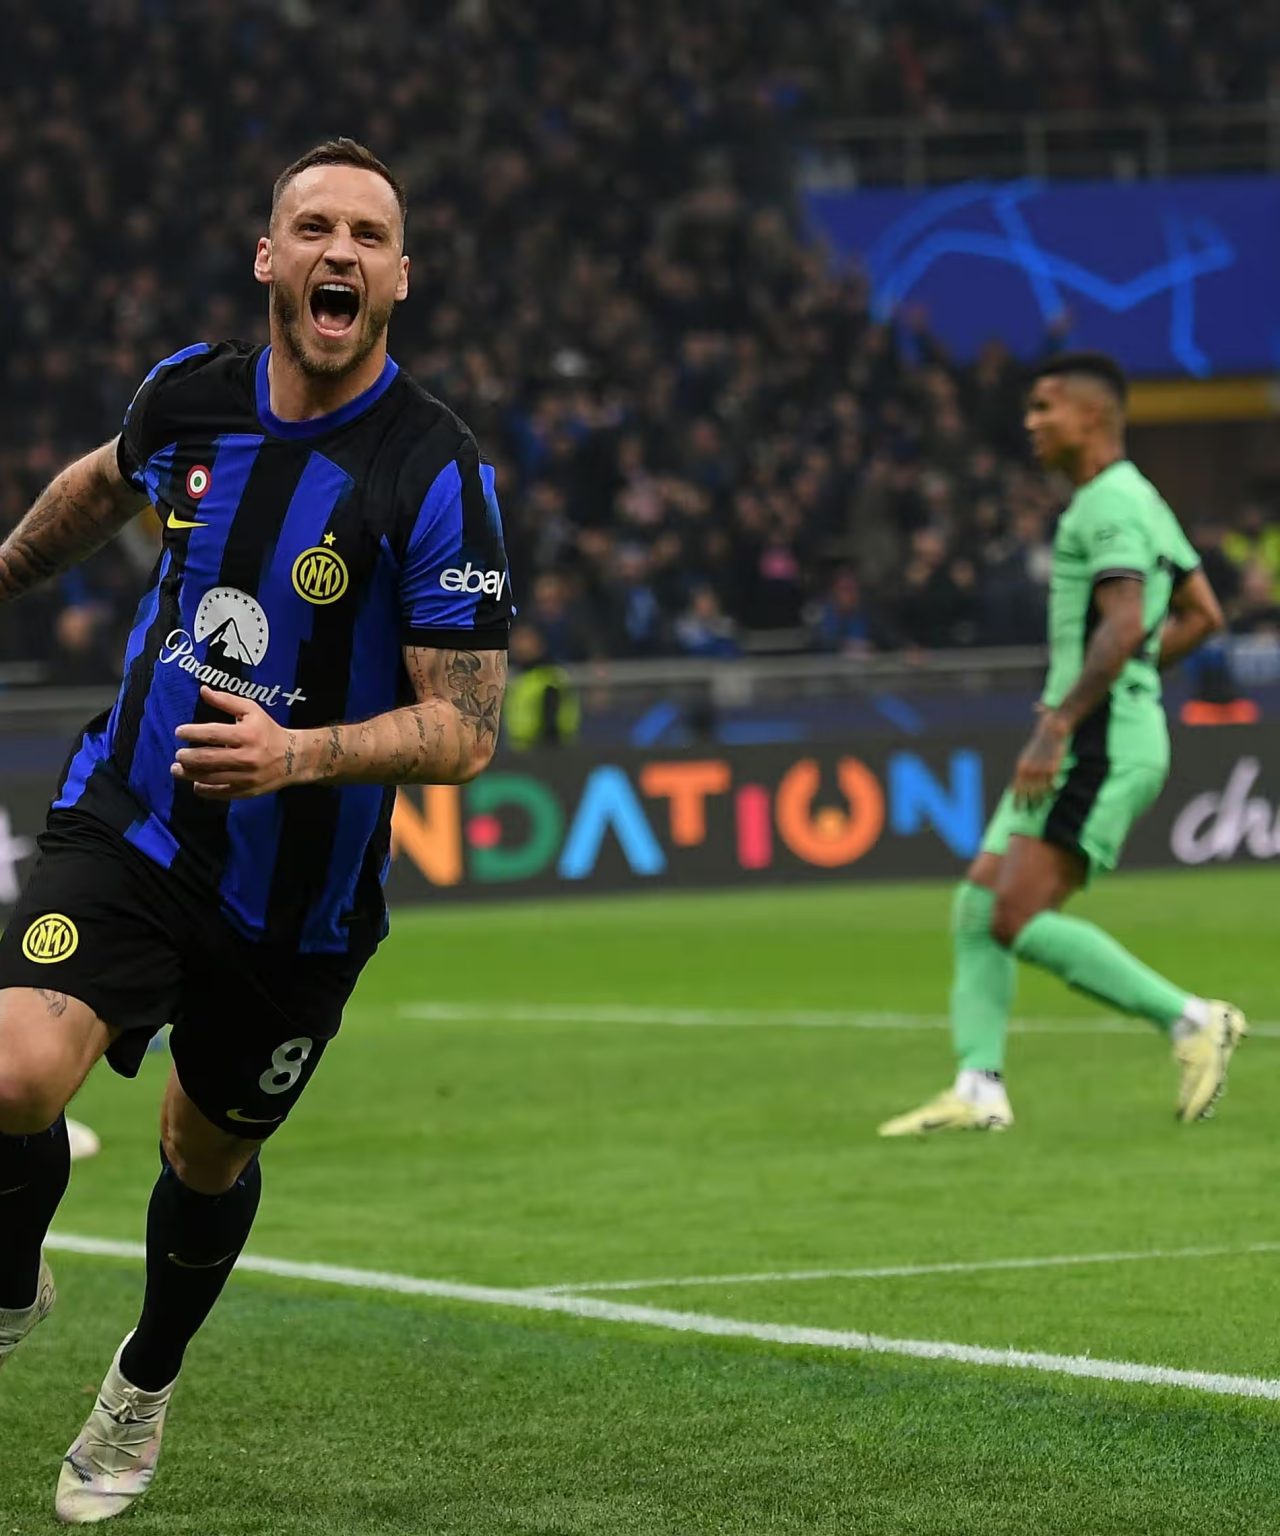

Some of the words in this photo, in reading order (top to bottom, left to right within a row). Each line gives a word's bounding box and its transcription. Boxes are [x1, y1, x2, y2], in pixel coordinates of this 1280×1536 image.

[439, 562, 506, 601] ebay
[159, 628, 307, 706] Paramount+
[390, 750, 984, 886] NDATION
[259, 1037, 313, 1094] 8
